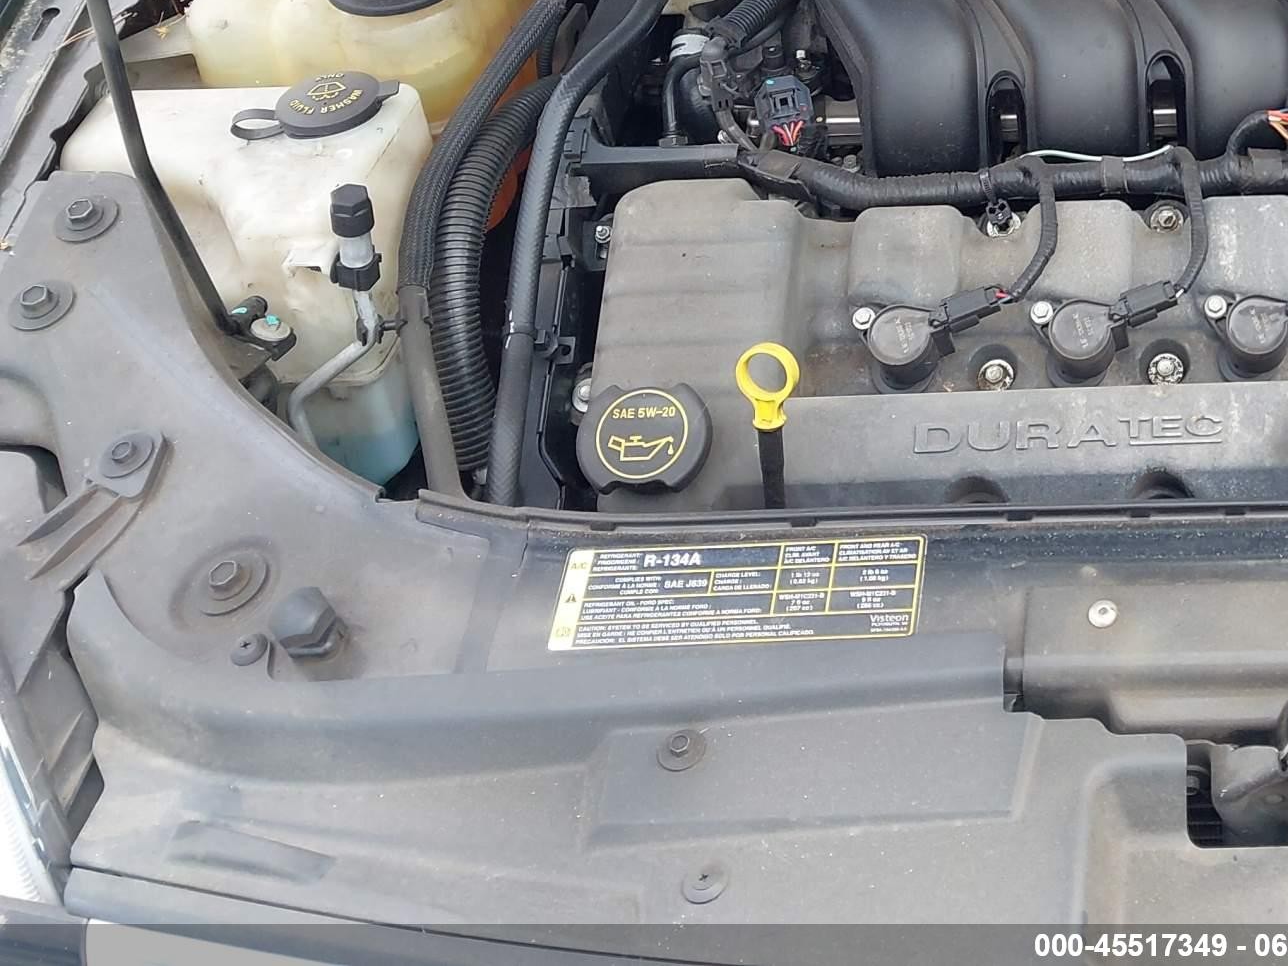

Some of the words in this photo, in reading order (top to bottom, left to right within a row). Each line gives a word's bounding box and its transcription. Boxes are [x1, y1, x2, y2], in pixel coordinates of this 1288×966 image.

[315, 72, 345, 82] ONLY
[290, 99, 315, 115] FLUID
[320, 89, 363, 114] WASHER
[612, 408, 635, 419] SAE
[637, 406, 676, 418] 5W-20
[913, 414, 1223, 453] DURATEC
[643, 551, 703, 567] R-134A
[663, 580, 685, 588] SAE
[685, 579, 708, 587] J639
[869, 612, 909, 622] Visteon
